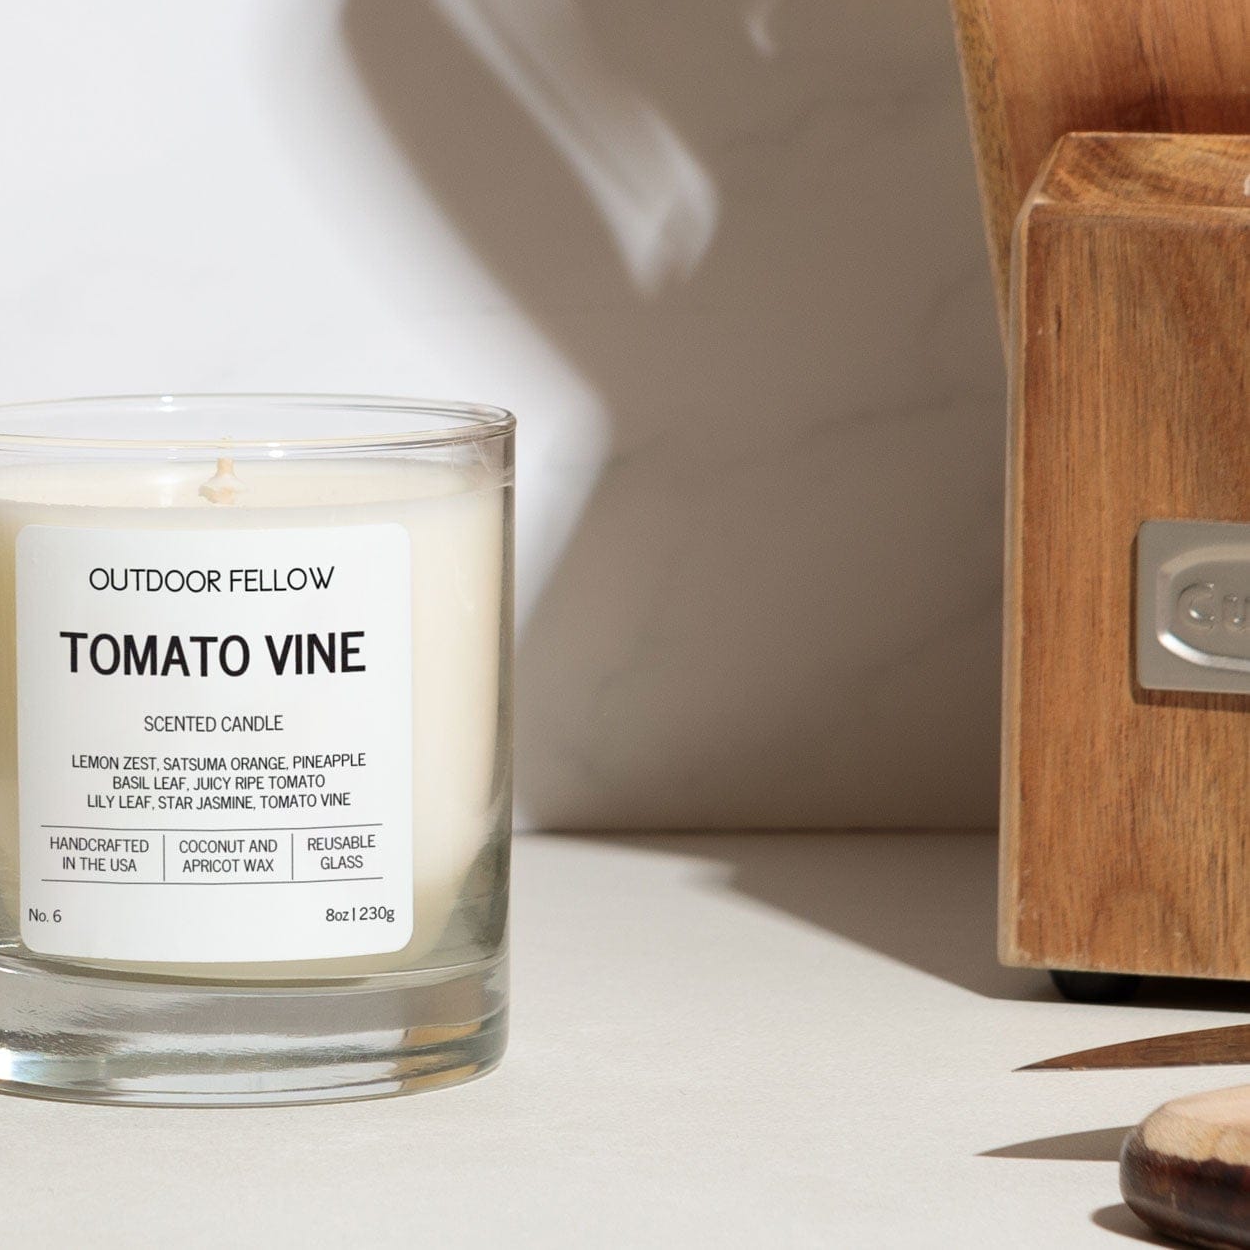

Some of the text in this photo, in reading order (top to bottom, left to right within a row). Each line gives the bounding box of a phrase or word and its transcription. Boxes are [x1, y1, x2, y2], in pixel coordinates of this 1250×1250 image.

[88, 565, 336, 594] OUTDOOR FELLOW
[58, 630, 367, 678] TOMATO VINE
[143, 714, 285, 733] SCENTED CANDLE
[71, 752, 367, 772] LEMON ZEST, SATSUMA ORANGE, PINEAPPLE
[112, 773, 326, 792] BASIL LEAF, JUICY RIPE TOMATO
[87, 791, 352, 811] LILY LEAF, STAR JASMINE, TOMATO VINE
[49, 835, 150, 854] HANDCRAFTED
[178, 838, 278, 854] COCONUT AND
[307, 833, 377, 852] REUSABLE
[62, 856, 138, 873] IN THE USA
[181, 858, 275, 874] APRICOT WAX
[320, 854, 364, 871] GLASS
[28, 907, 62, 924] No. 6
